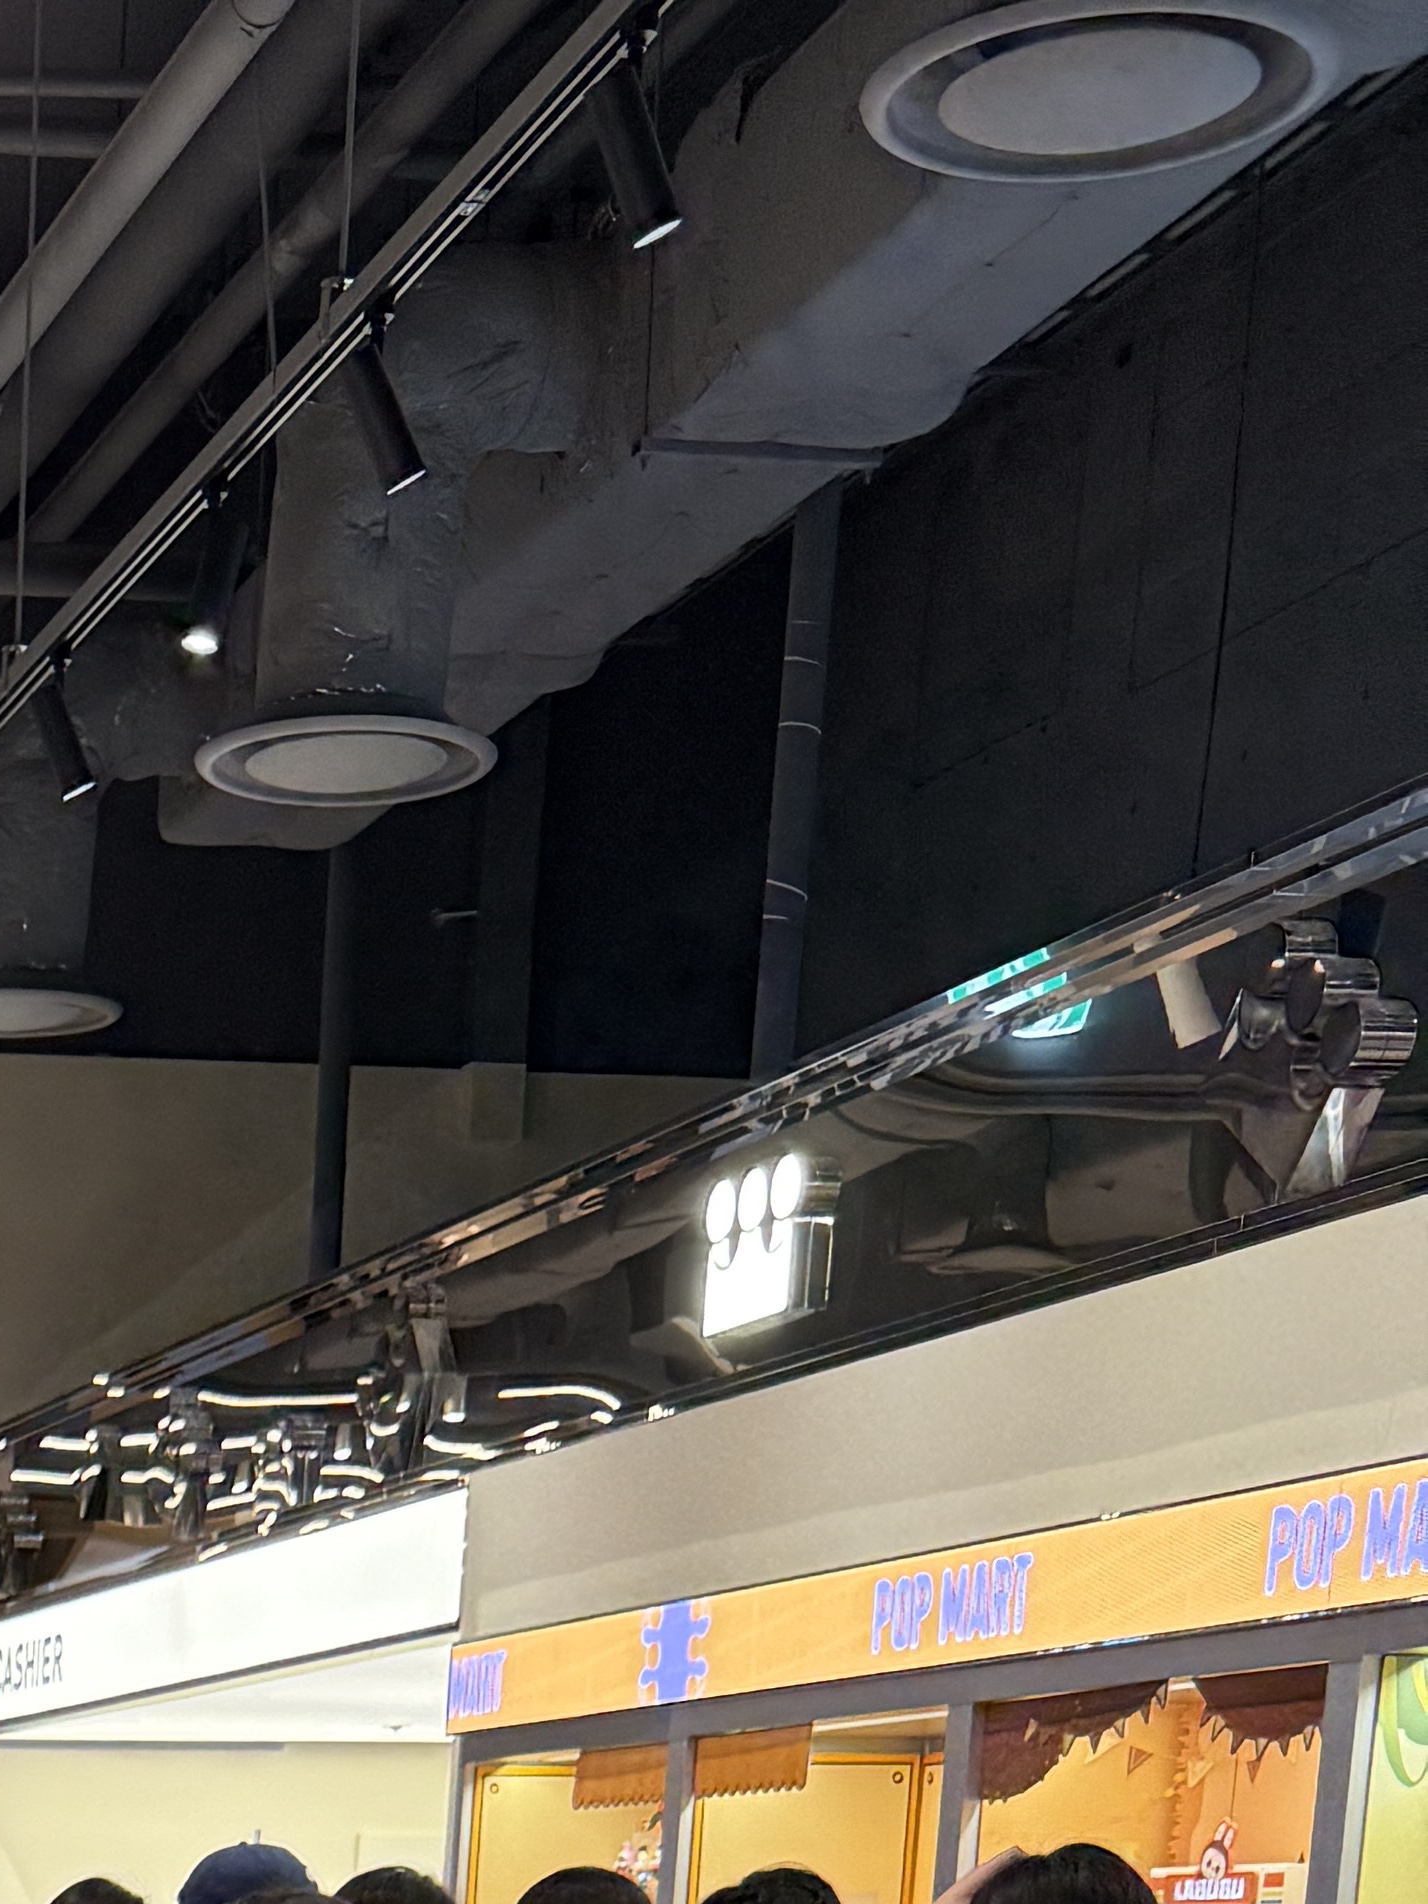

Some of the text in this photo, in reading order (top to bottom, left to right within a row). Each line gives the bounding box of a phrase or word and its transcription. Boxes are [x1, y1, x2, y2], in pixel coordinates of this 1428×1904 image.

[1263, 1493, 1354, 1597] POP
[871, 1552, 1034, 1656] POP MART
[1173, 1875, 1246, 1901] LABUBU
